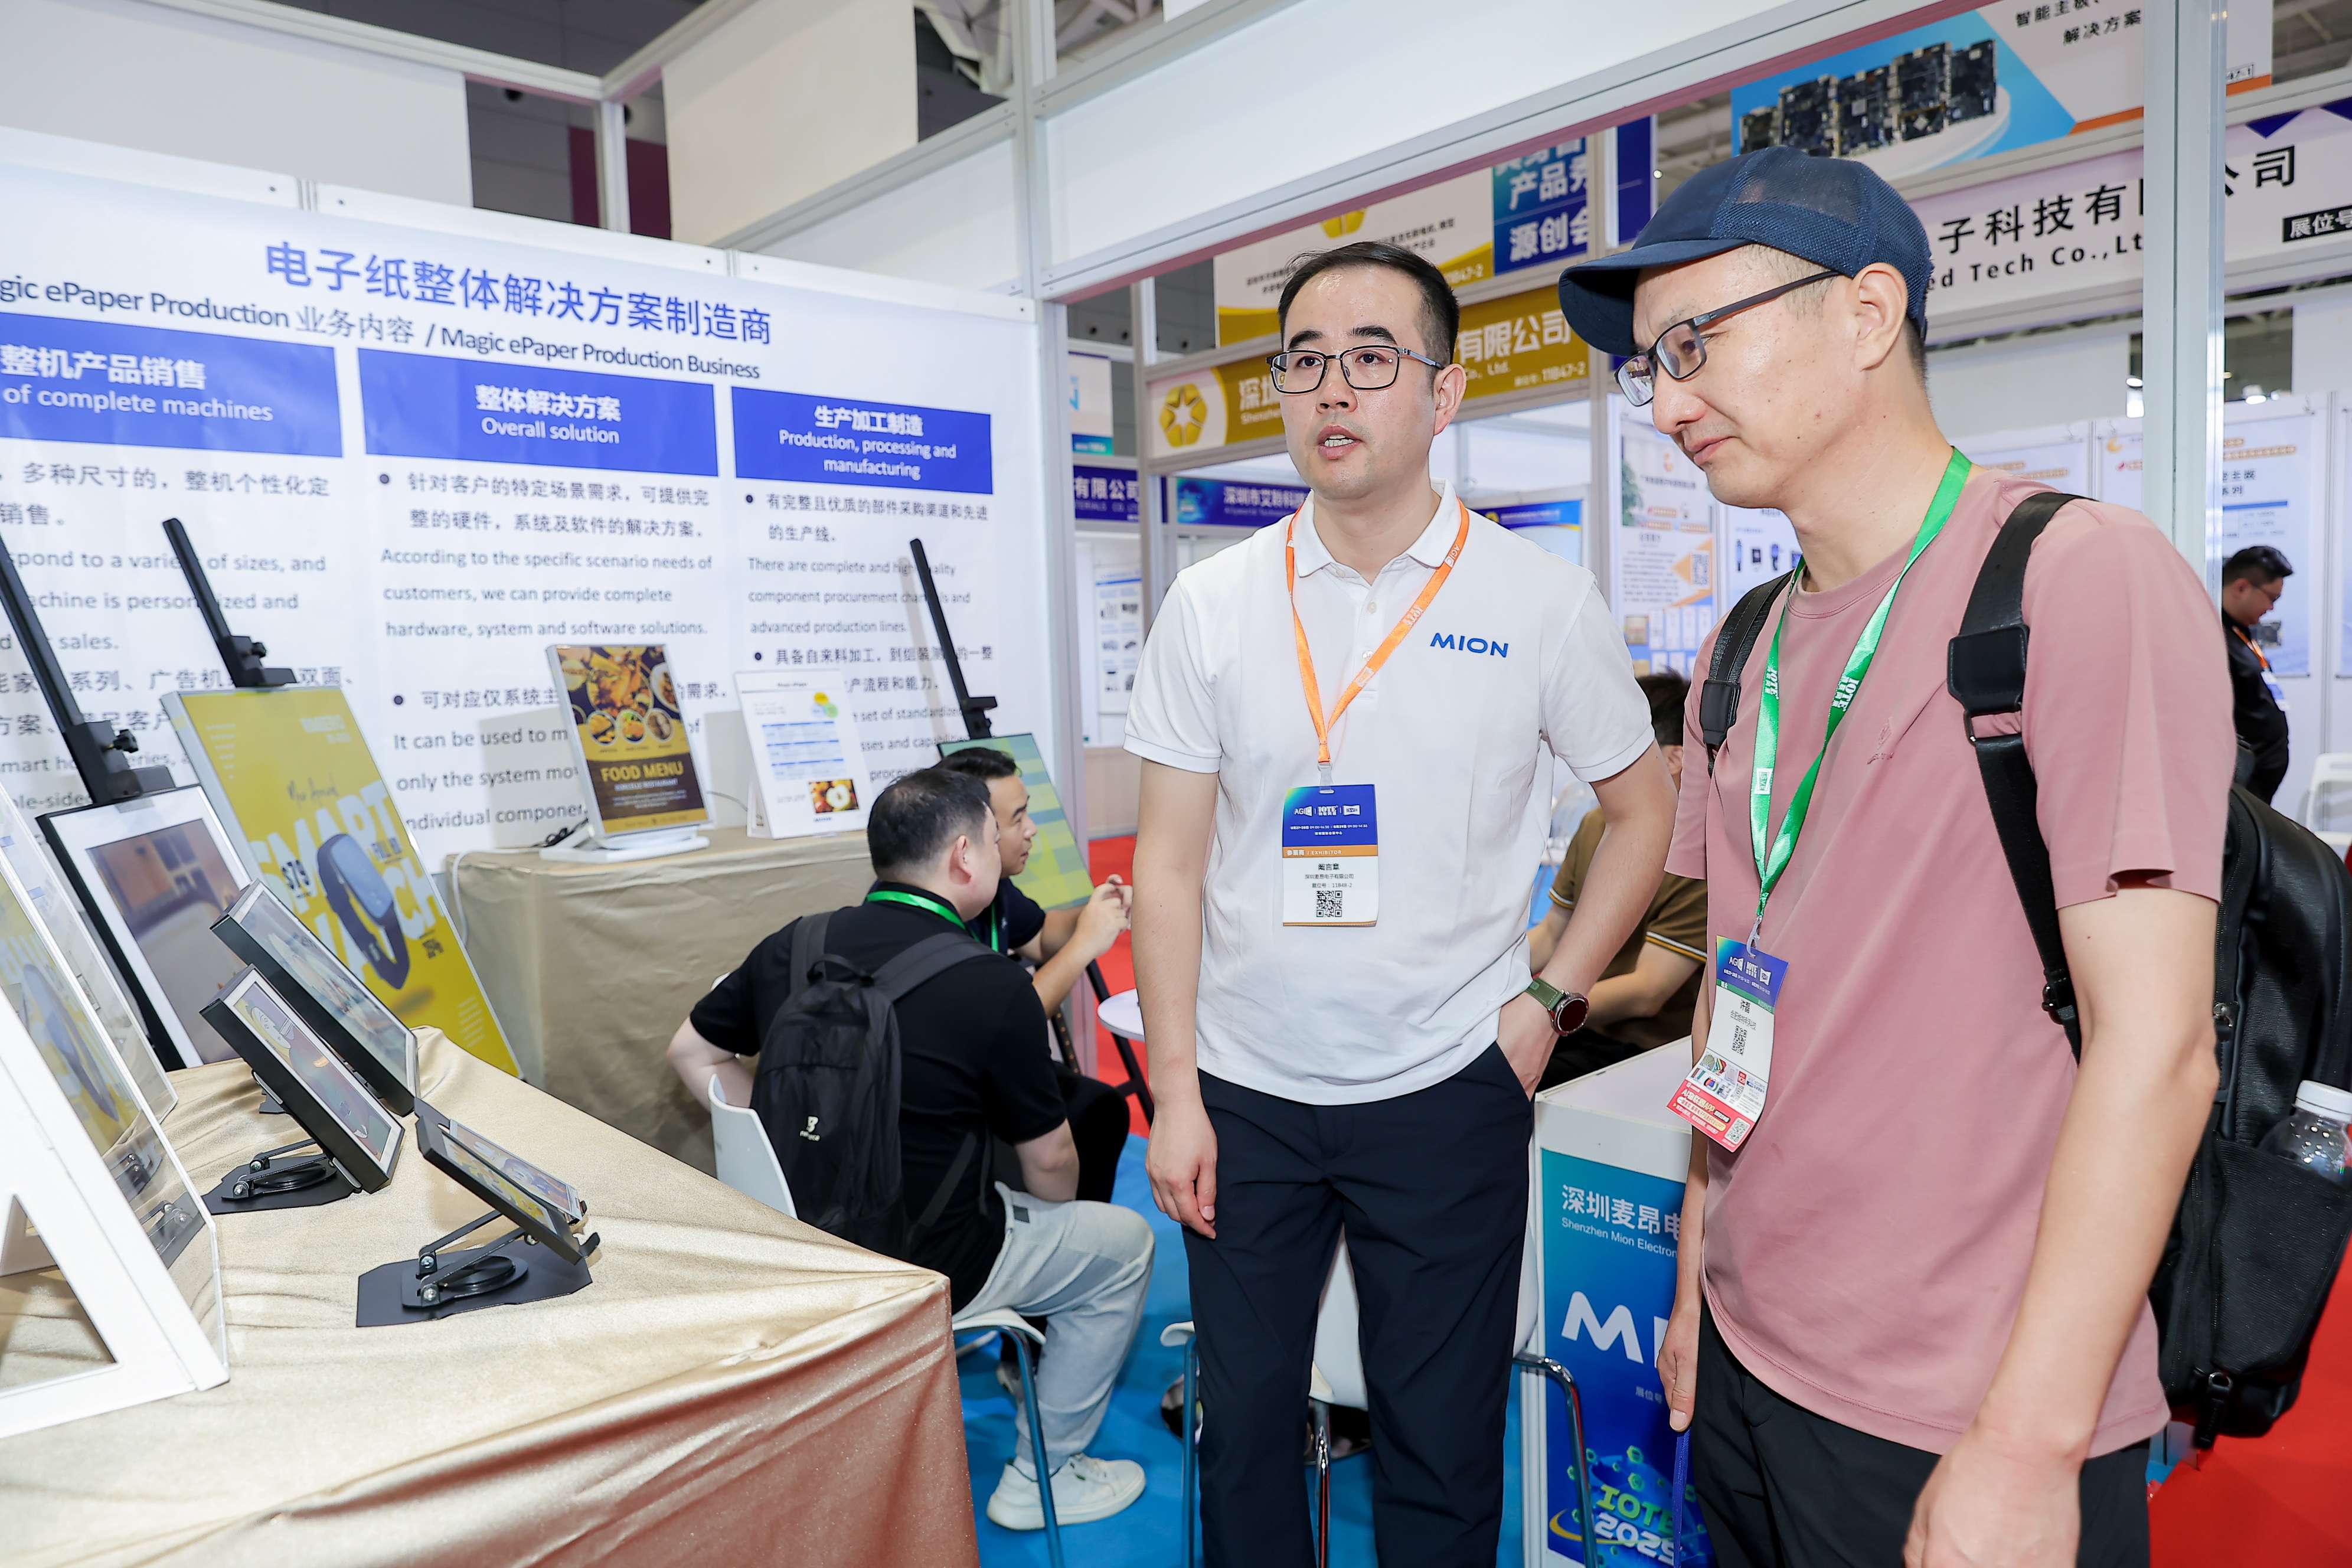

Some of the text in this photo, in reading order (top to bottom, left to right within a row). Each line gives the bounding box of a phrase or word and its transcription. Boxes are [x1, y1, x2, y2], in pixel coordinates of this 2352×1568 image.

[1970, 253, 2033, 282] Tech
[266, 241, 772, 345] 电子纸整体解决方案制造商
[46, 282, 143, 312] ePaper
[151, 293, 289, 328] Production
[296, 306, 414, 344] 业务内容
[442, 327, 506, 354] Magic
[509, 339, 578, 361] ePaper
[582, 344, 683, 371] Production
[688, 355, 760, 379] Business
[1458, 309, 1571, 364] 有限公司
[0, 344, 207, 391] 整机产品销售
[3, 384, 274, 422] of complete machines
[475, 383, 622, 423] 整体解决方案
[481, 417, 620, 445] Overall solution
[814, 405, 924, 437] 生产加工制造
[778, 429, 957, 460] Production, processing and
[824, 458, 921, 481] manufacturing
[1074, 475, 1139, 501] 有限公司
[81, 554, 103, 568] to
[110, 556, 122, 568] a
[207, 553, 229, 569] of
[234, 554, 285, 573] sizes,
[290, 556, 326, 571] and
[381, 549, 713, 570] According to the specific scenario needs of
[748, 557, 785, 571] There
[788, 561, 807, 572] are
[811, 561, 866, 575] complete
[869, 562, 890, 574] and
[104, 594, 119, 609] is
[262, 595, 299, 609] and
[383, 587, 672, 605] customers, we can provide complete
[748, 592, 820, 605] component
[824, 592, 898, 605] procurement
[951, 593, 970, 603] and
[386, 620, 708, 639] hardware, system and software solutions.
[750, 621, 811, 634] advanced
[814, 621, 877, 635] production
[60, 633, 119, 649] sales.
[1430, 632, 1509, 658] MION
[880, 709, 893, 720] of
[393, 734, 408, 750] It
[413, 736, 446, 750] can
[451, 731, 475, 747] be
[480, 729, 523, 746] used
[528, 729, 547, 743] to
[887, 737, 910, 750] and
[396, 773, 437, 792] only
[443, 772, 473, 788] the
[479, 768, 541, 788] system
[600, 764, 641, 782] FOOD
[642, 760, 684, 779] MENU
[406, 808, 491, 831] ndividual
[1561, 1217, 1609, 1239] Shenzhen
[1611, 1230, 1635, 1247] Mion
[1596, 1484, 1674, 1535] IOTE
